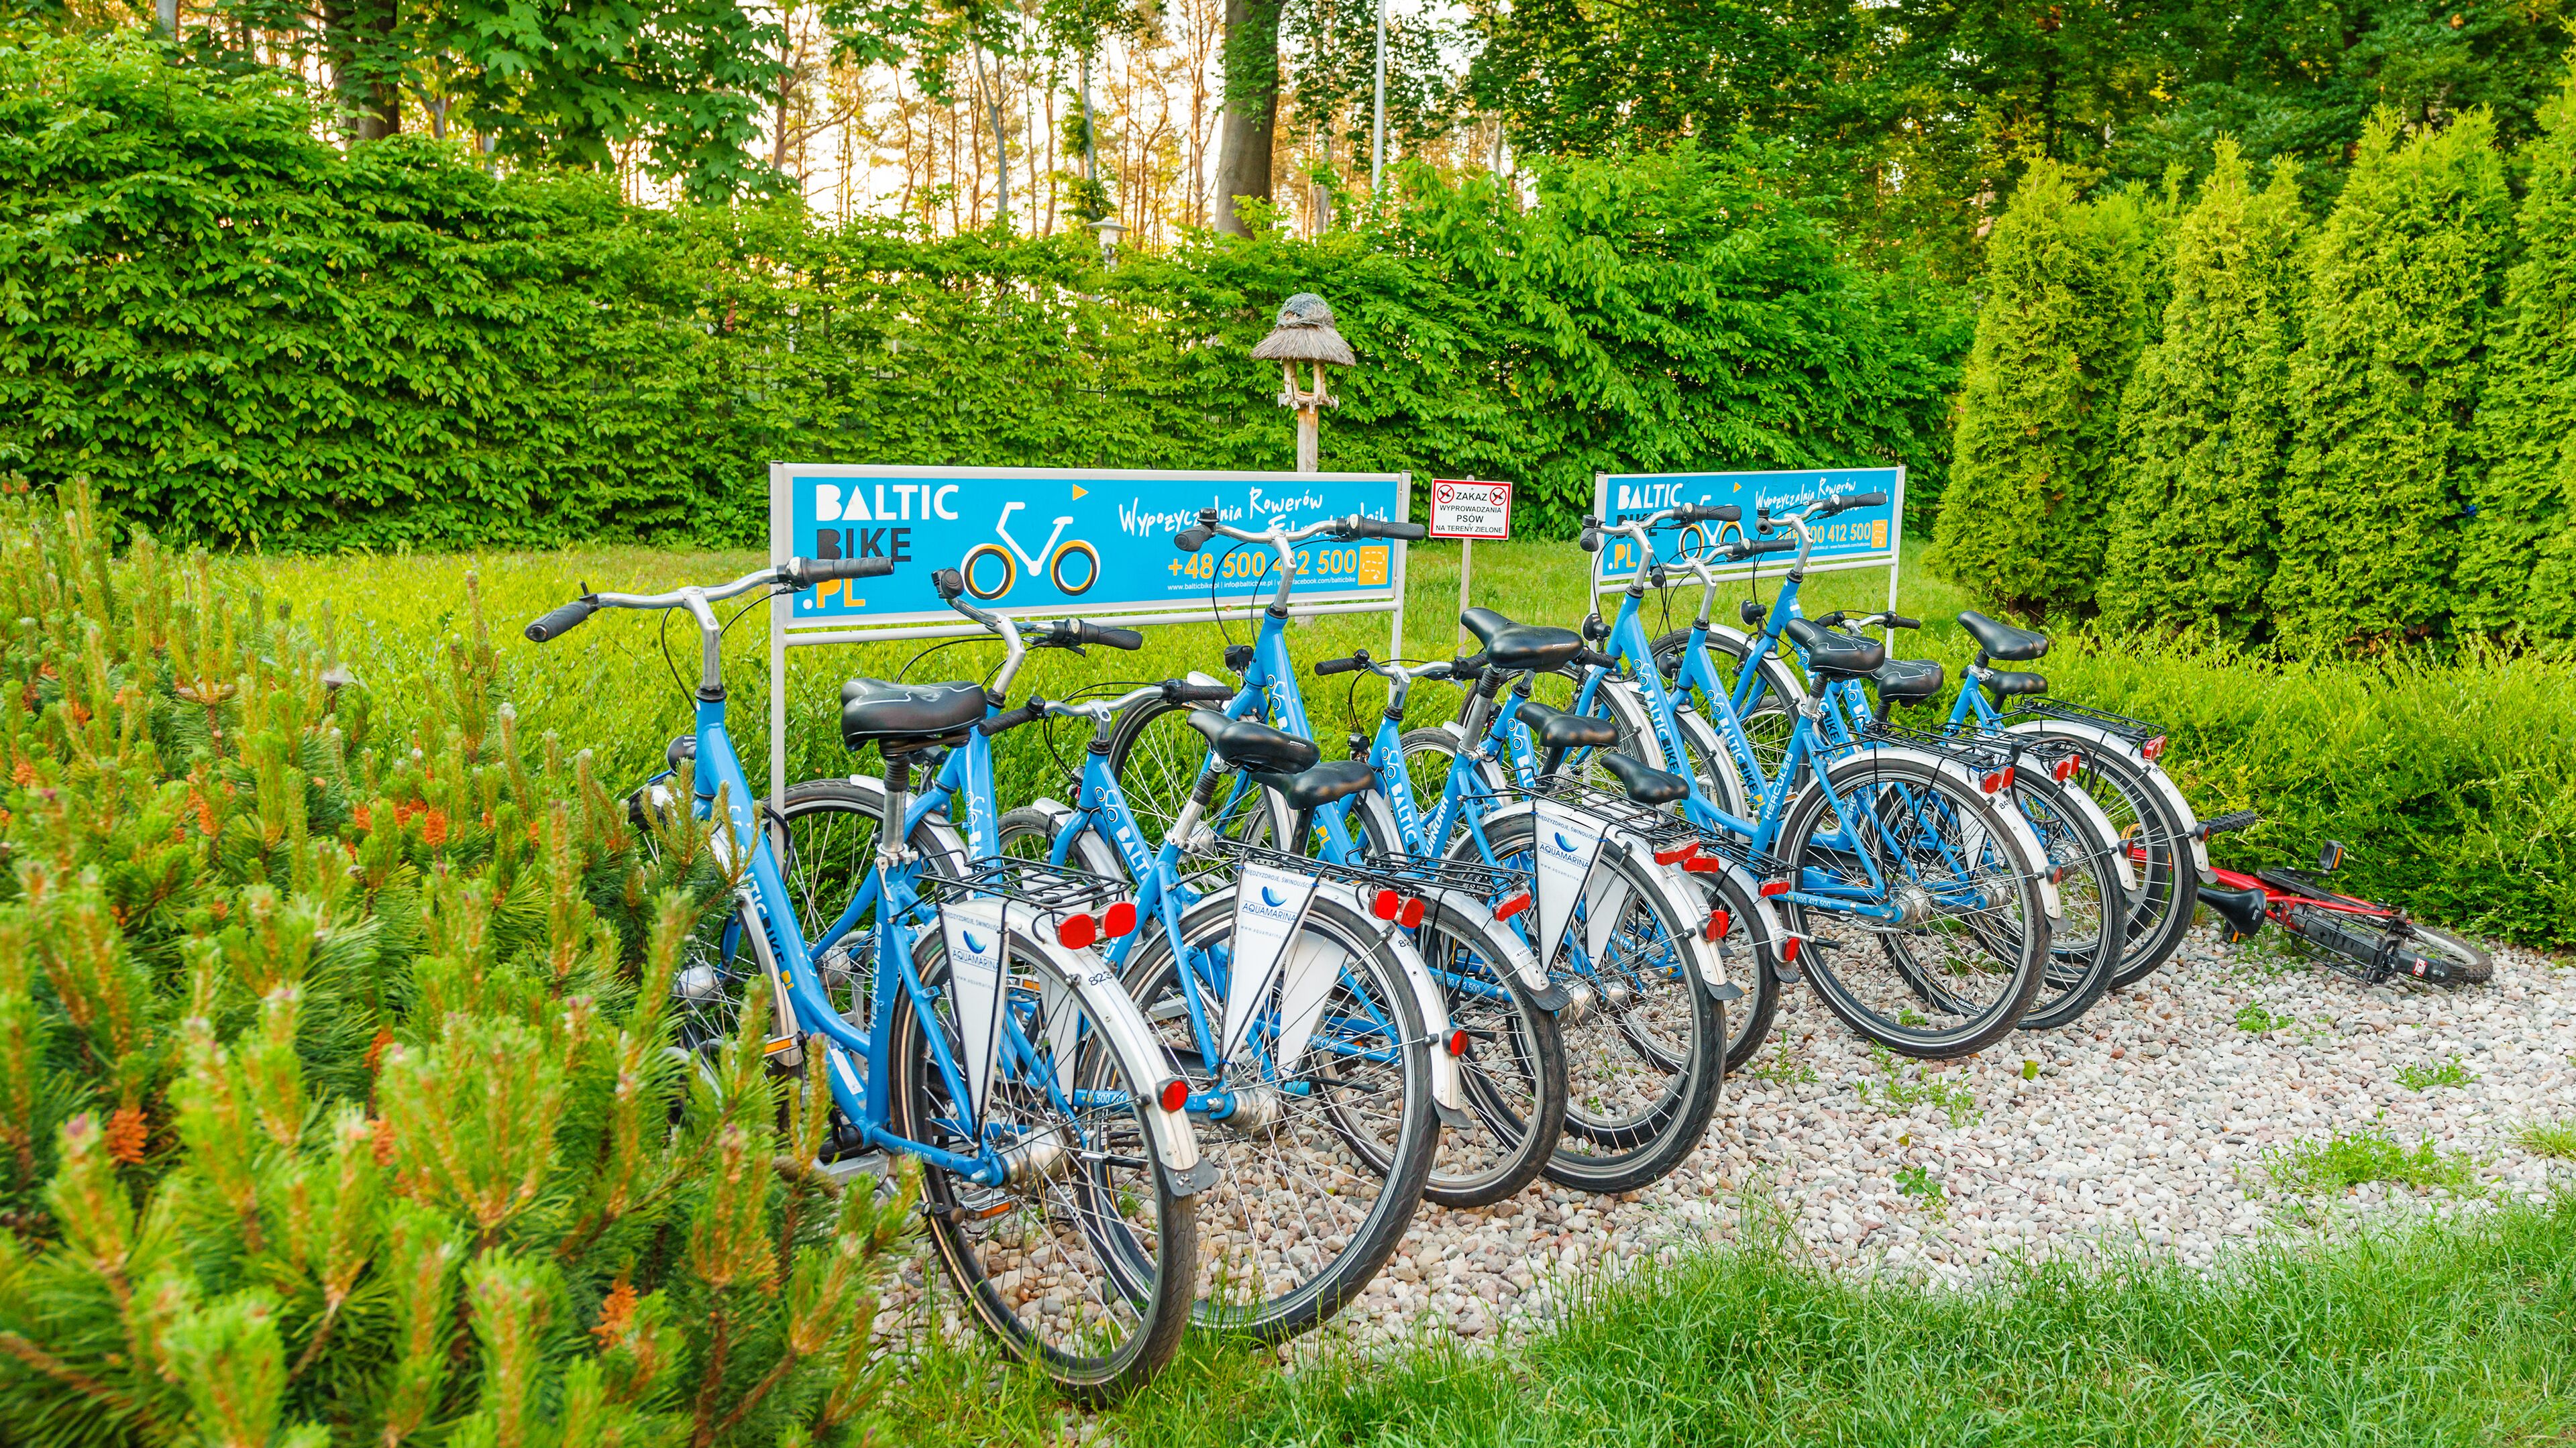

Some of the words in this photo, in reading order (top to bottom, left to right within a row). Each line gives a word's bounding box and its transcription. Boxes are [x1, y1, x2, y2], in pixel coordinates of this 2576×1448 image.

[1456, 492, 1487, 501] ZAKAZ
[1617, 483, 1684, 510] BALTIC
[1817, 477, 1856, 499] Rowerów
[816, 484, 959, 521] BALTIC
[1119, 494, 1242, 537] Wypozyczlnia
[1249, 486, 1323, 520] Rowerów
[1440, 504, 1502, 514] WYPROWADZANIA
[1456, 513, 1484, 523] PSÓW
[1807, 525, 1824, 544] 00
[1827, 524, 1847, 542] 412
[1850, 523, 1871, 541] 500
[816, 527, 912, 563] BIKE
[1168, 553, 1214, 579] +48
[1222, 551, 1266, 578] 500
[1273, 550, 1309, 575] 42
[1317, 549, 1356, 575] 500
[1608, 543, 1637, 570] .PL
[803, 577, 866, 609] .PL
[1167, 582, 1220, 590] www.balticbikepl
[1224, 579, 1273, 588] info@balticbke.pl
[1644, 689, 1683, 778] BALTICBIKE.
[1764, 752, 1793, 820] HERCULES
[1540, 844, 1590, 869] AQUAMARINA
[1540, 862, 1584, 883] www.aquamarina.
[1242, 902, 1297, 922] AQUAMARINA
[1241, 925, 1286, 940] www.aquamarina.
[953, 949, 999, 970] AQUAMARINA
[1089, 971, 1112, 985] 823
[1468, 983, 1481, 993] 500
[1096, 1093, 1111, 1104] 500
